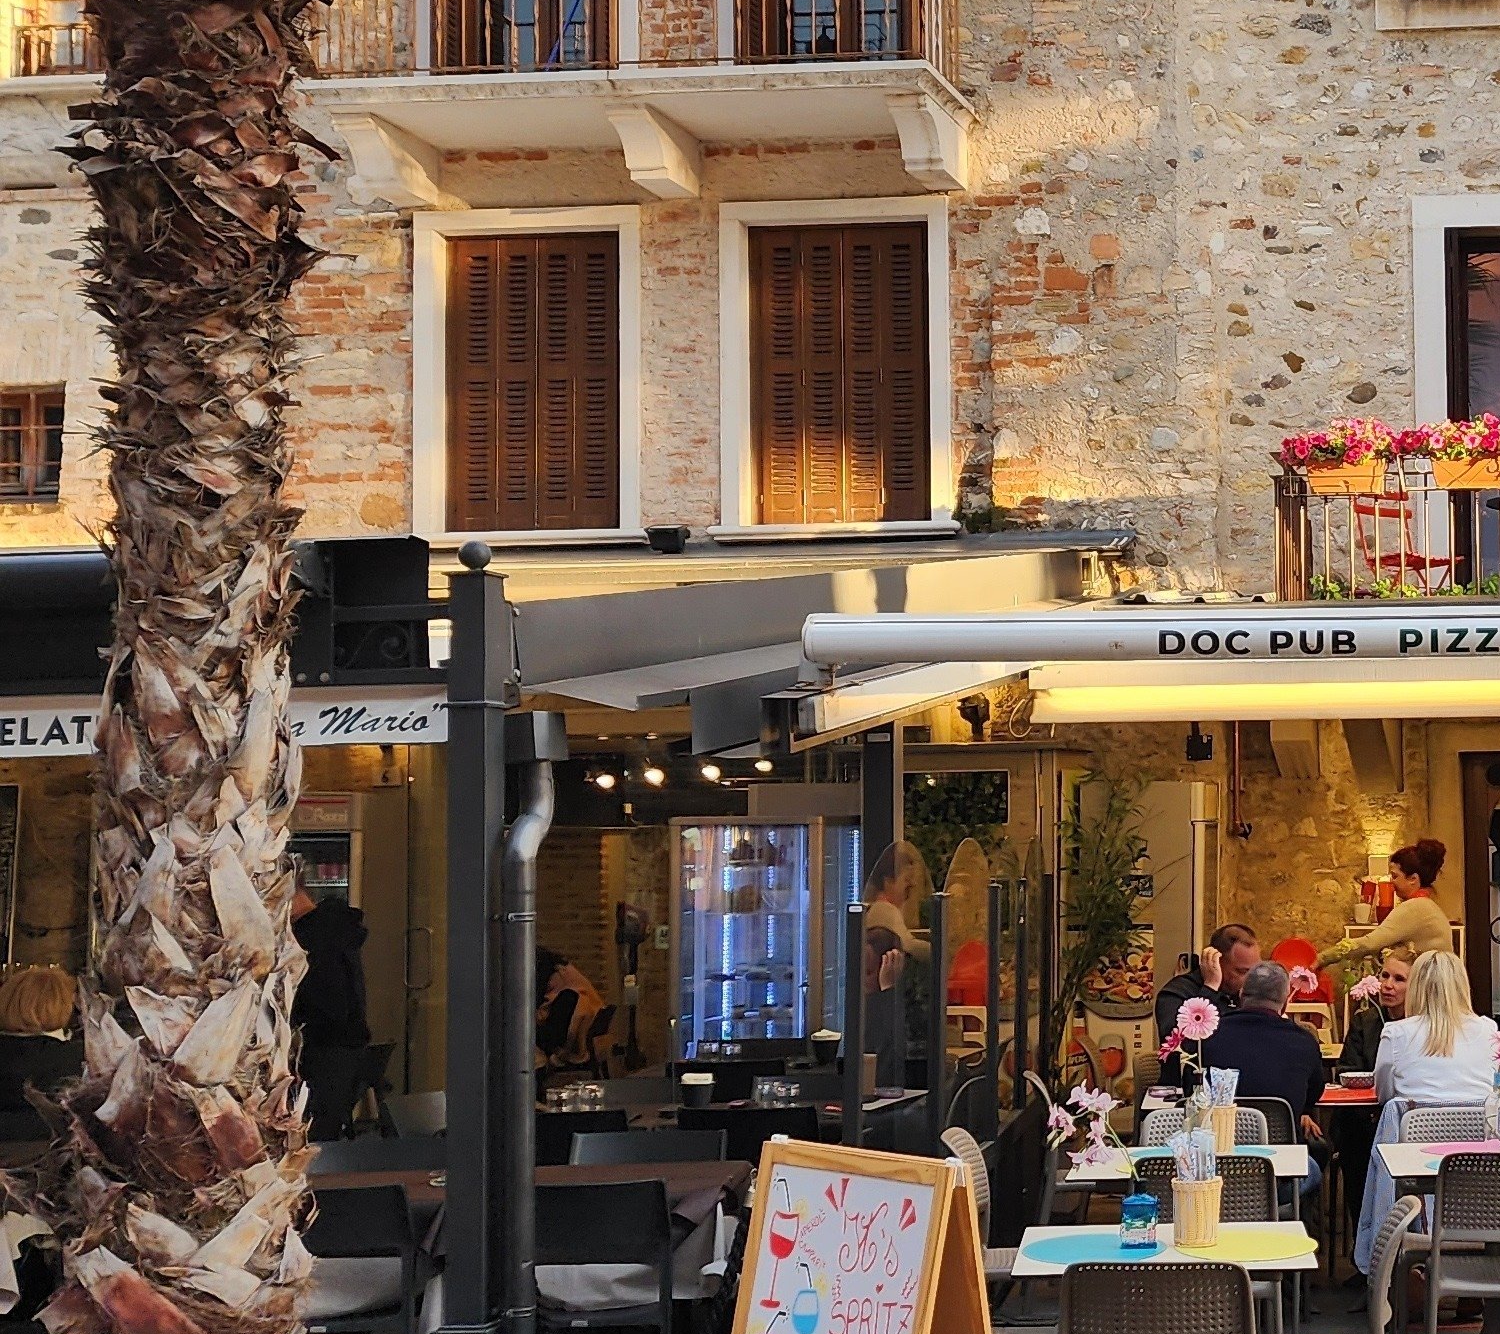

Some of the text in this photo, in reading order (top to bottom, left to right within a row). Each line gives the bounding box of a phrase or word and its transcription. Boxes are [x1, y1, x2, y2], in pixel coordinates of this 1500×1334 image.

[1158, 629, 1251, 655] DOC
[1270, 629, 1357, 655] PUB
[0, 716, 100, 746] ELAT
